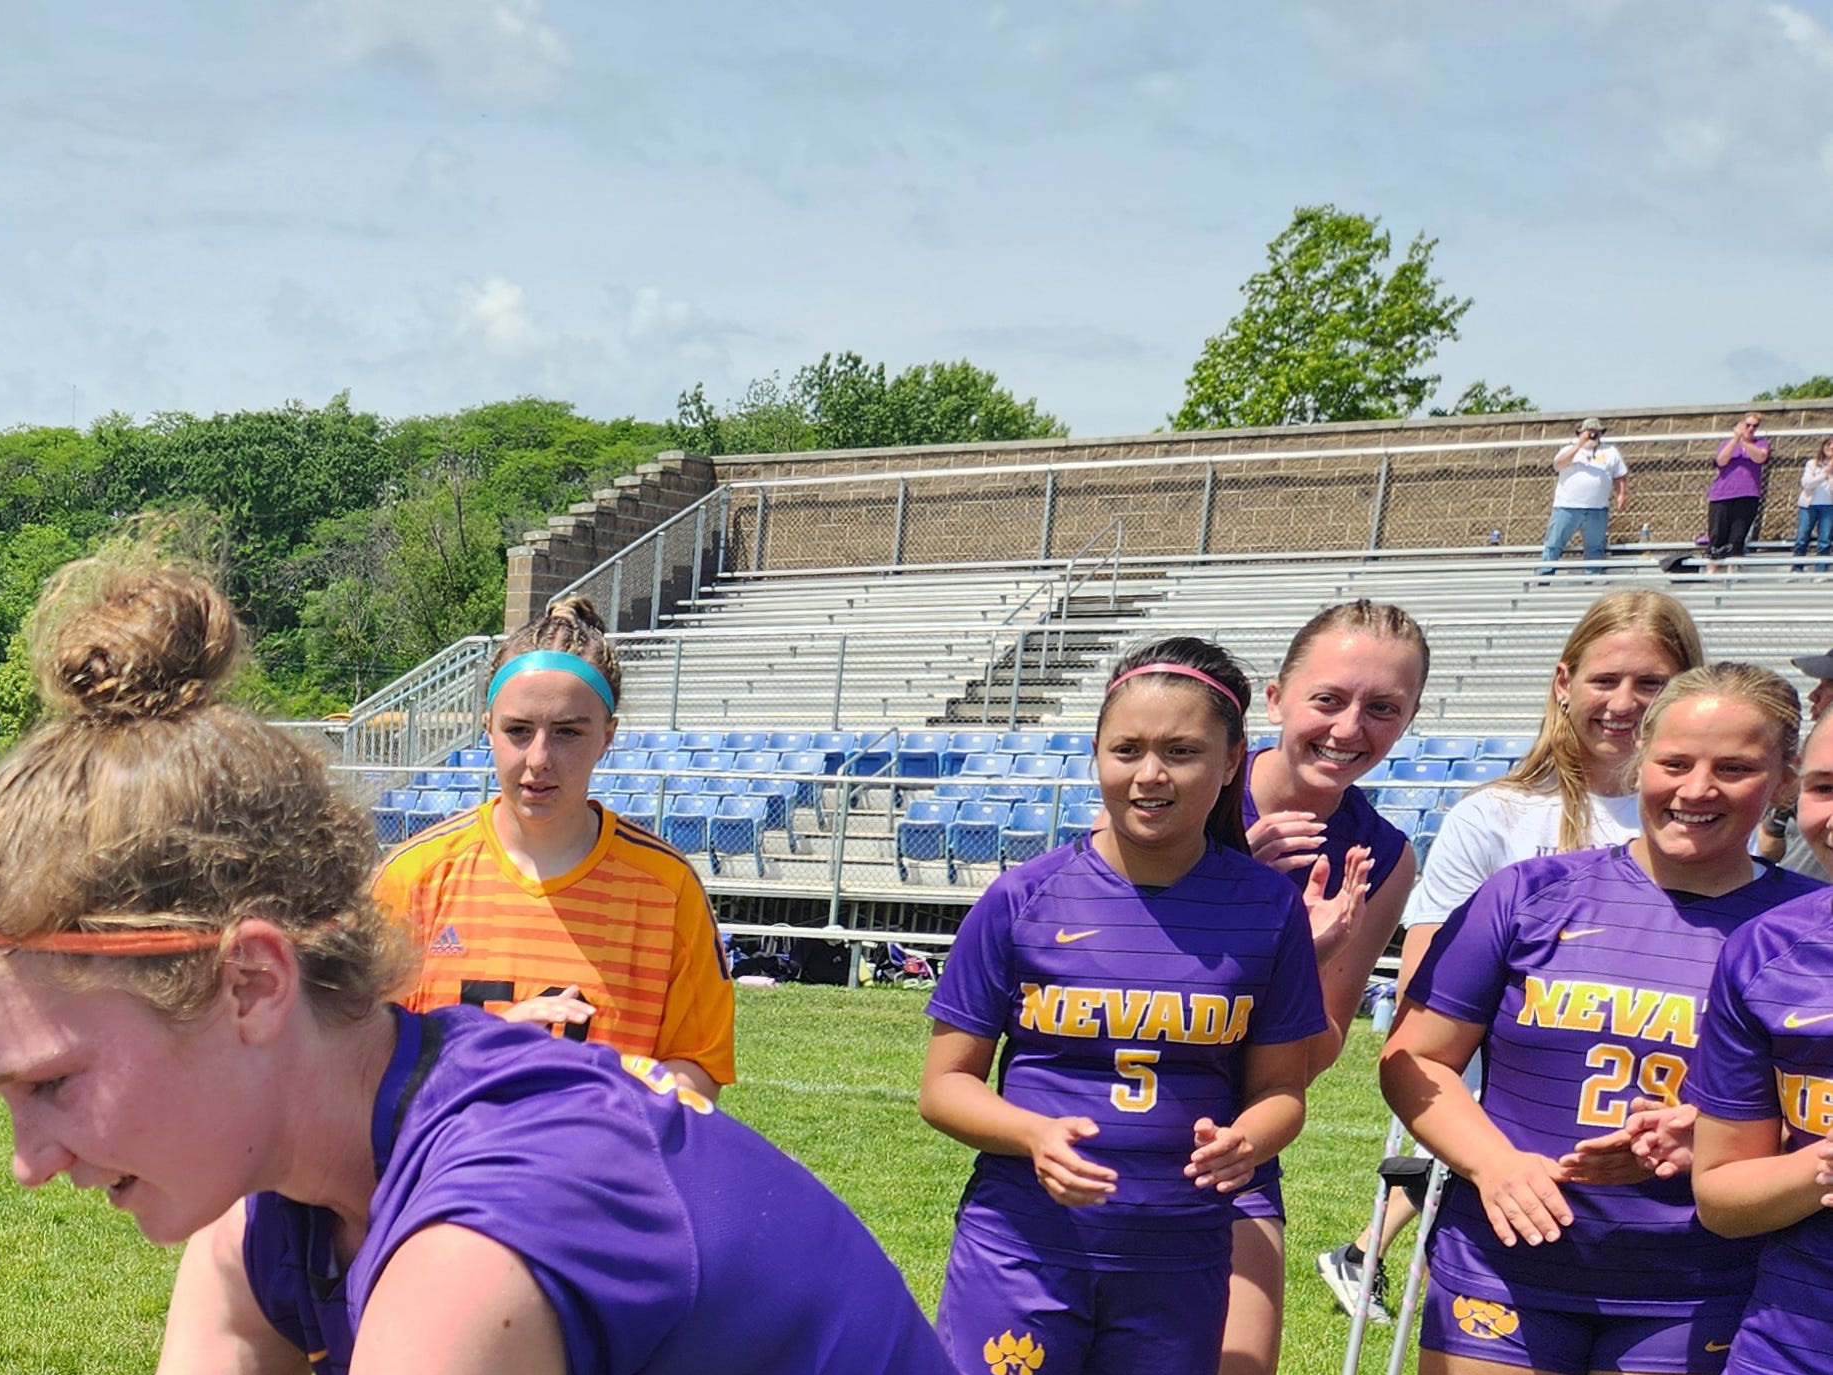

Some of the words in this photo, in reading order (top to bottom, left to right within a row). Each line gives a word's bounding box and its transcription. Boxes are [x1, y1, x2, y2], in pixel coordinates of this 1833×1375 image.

[1019, 982, 1254, 1045] NEVADA
[1517, 975, 1700, 1048] NEVA
[1110, 1048, 1161, 1113] 5
[1576, 1042, 1689, 1128] 29
